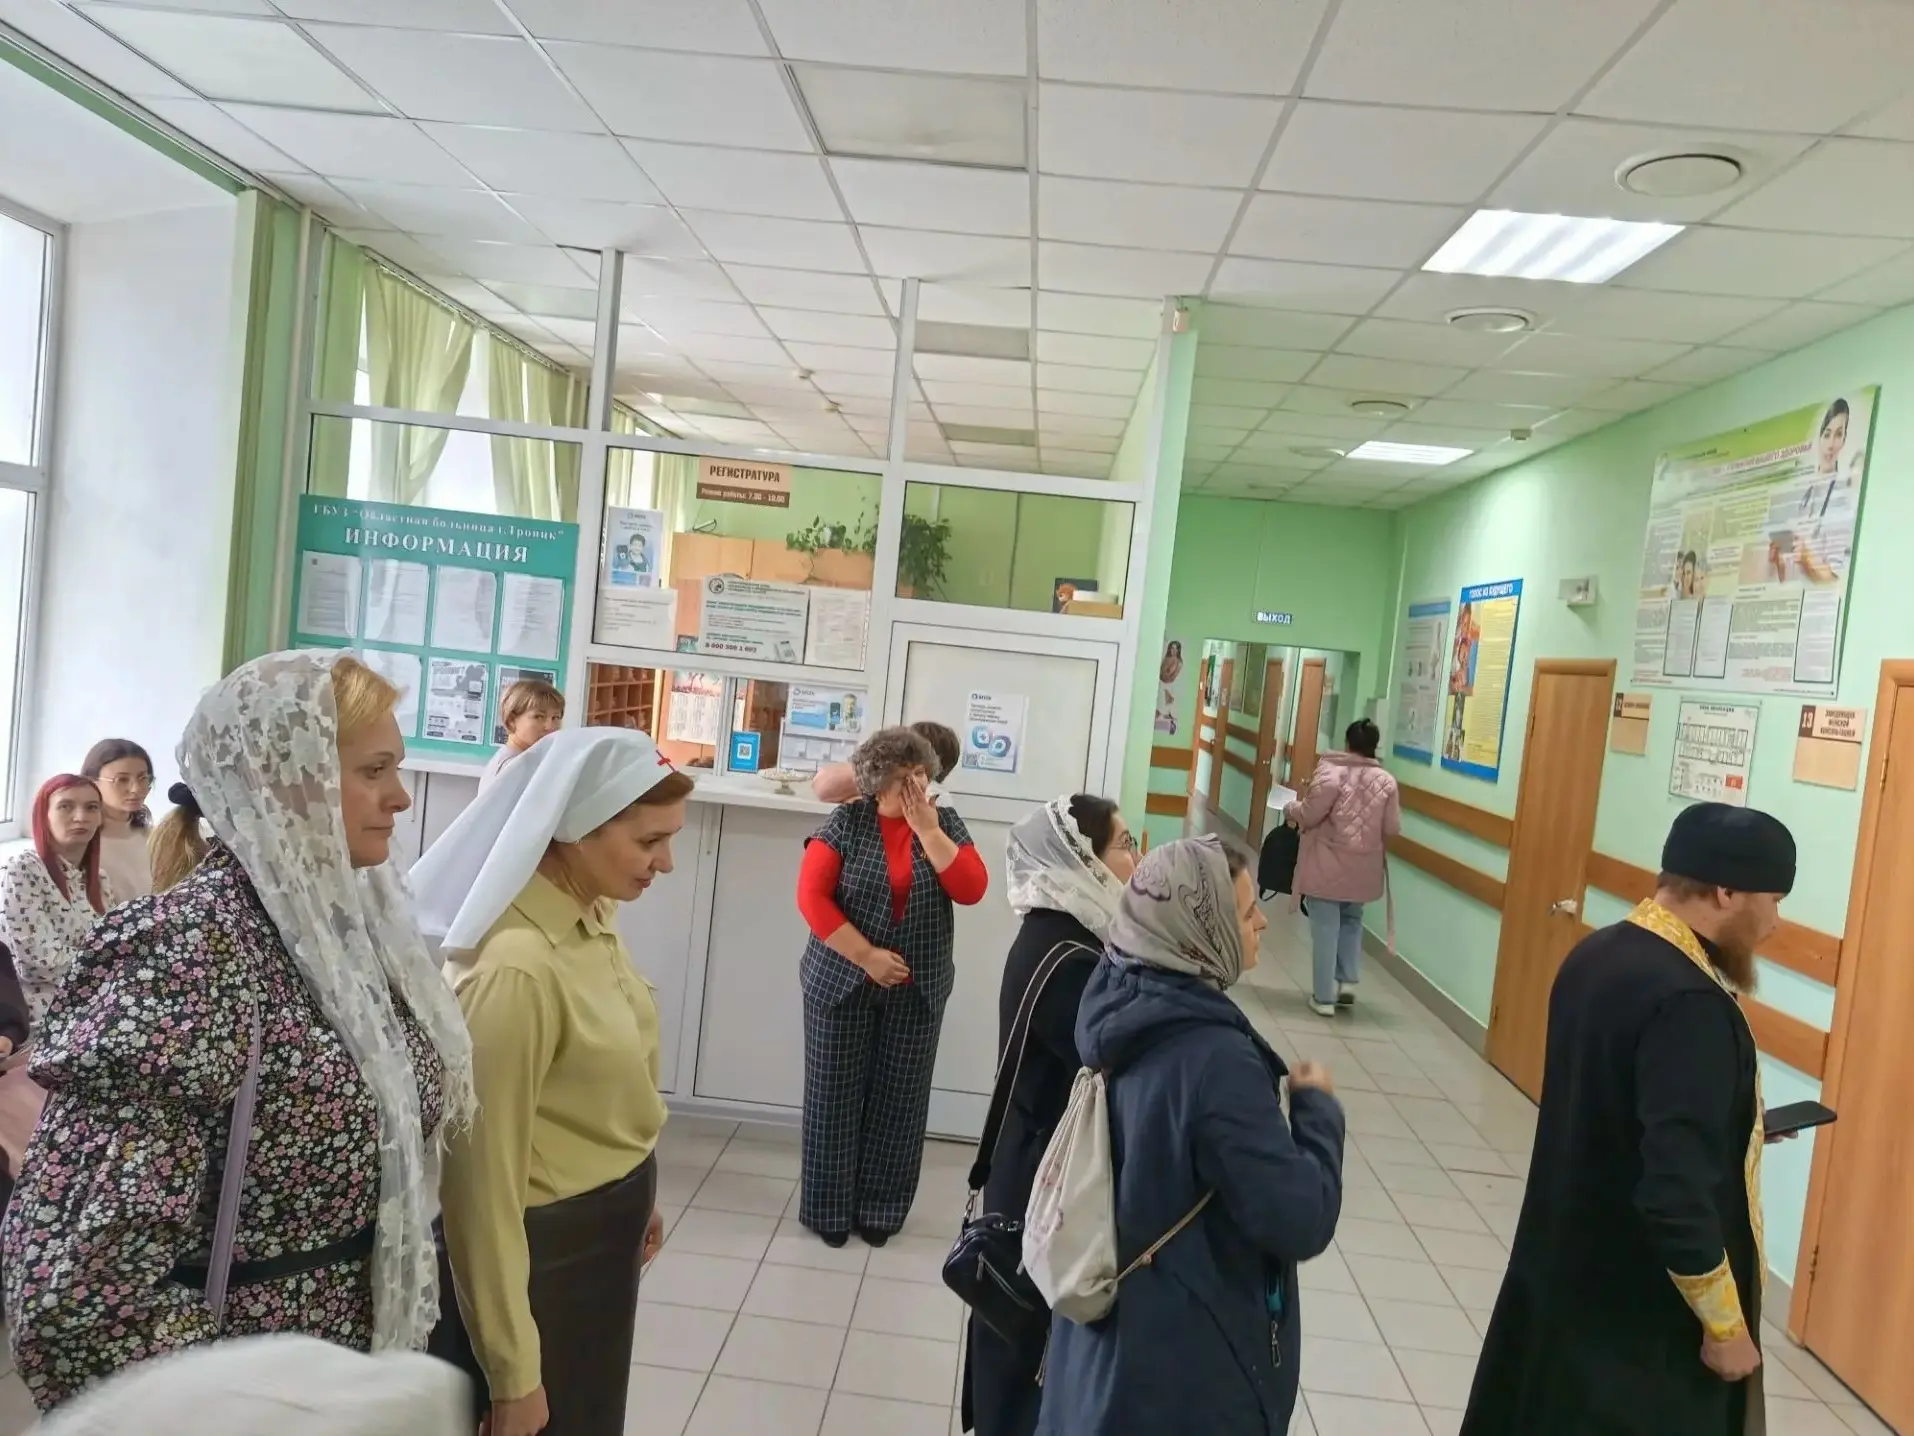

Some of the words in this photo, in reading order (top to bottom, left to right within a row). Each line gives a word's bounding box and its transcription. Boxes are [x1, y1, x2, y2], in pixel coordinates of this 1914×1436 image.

[709, 465, 780, 483] РЕГИСТРАТУРА
[431, 516, 494, 534] больница
[345, 527, 528, 564] ИНФОРМАЦИЯ
[1257, 611, 1291, 624] ВЫХОД
[1801, 711, 1814, 729] 13
